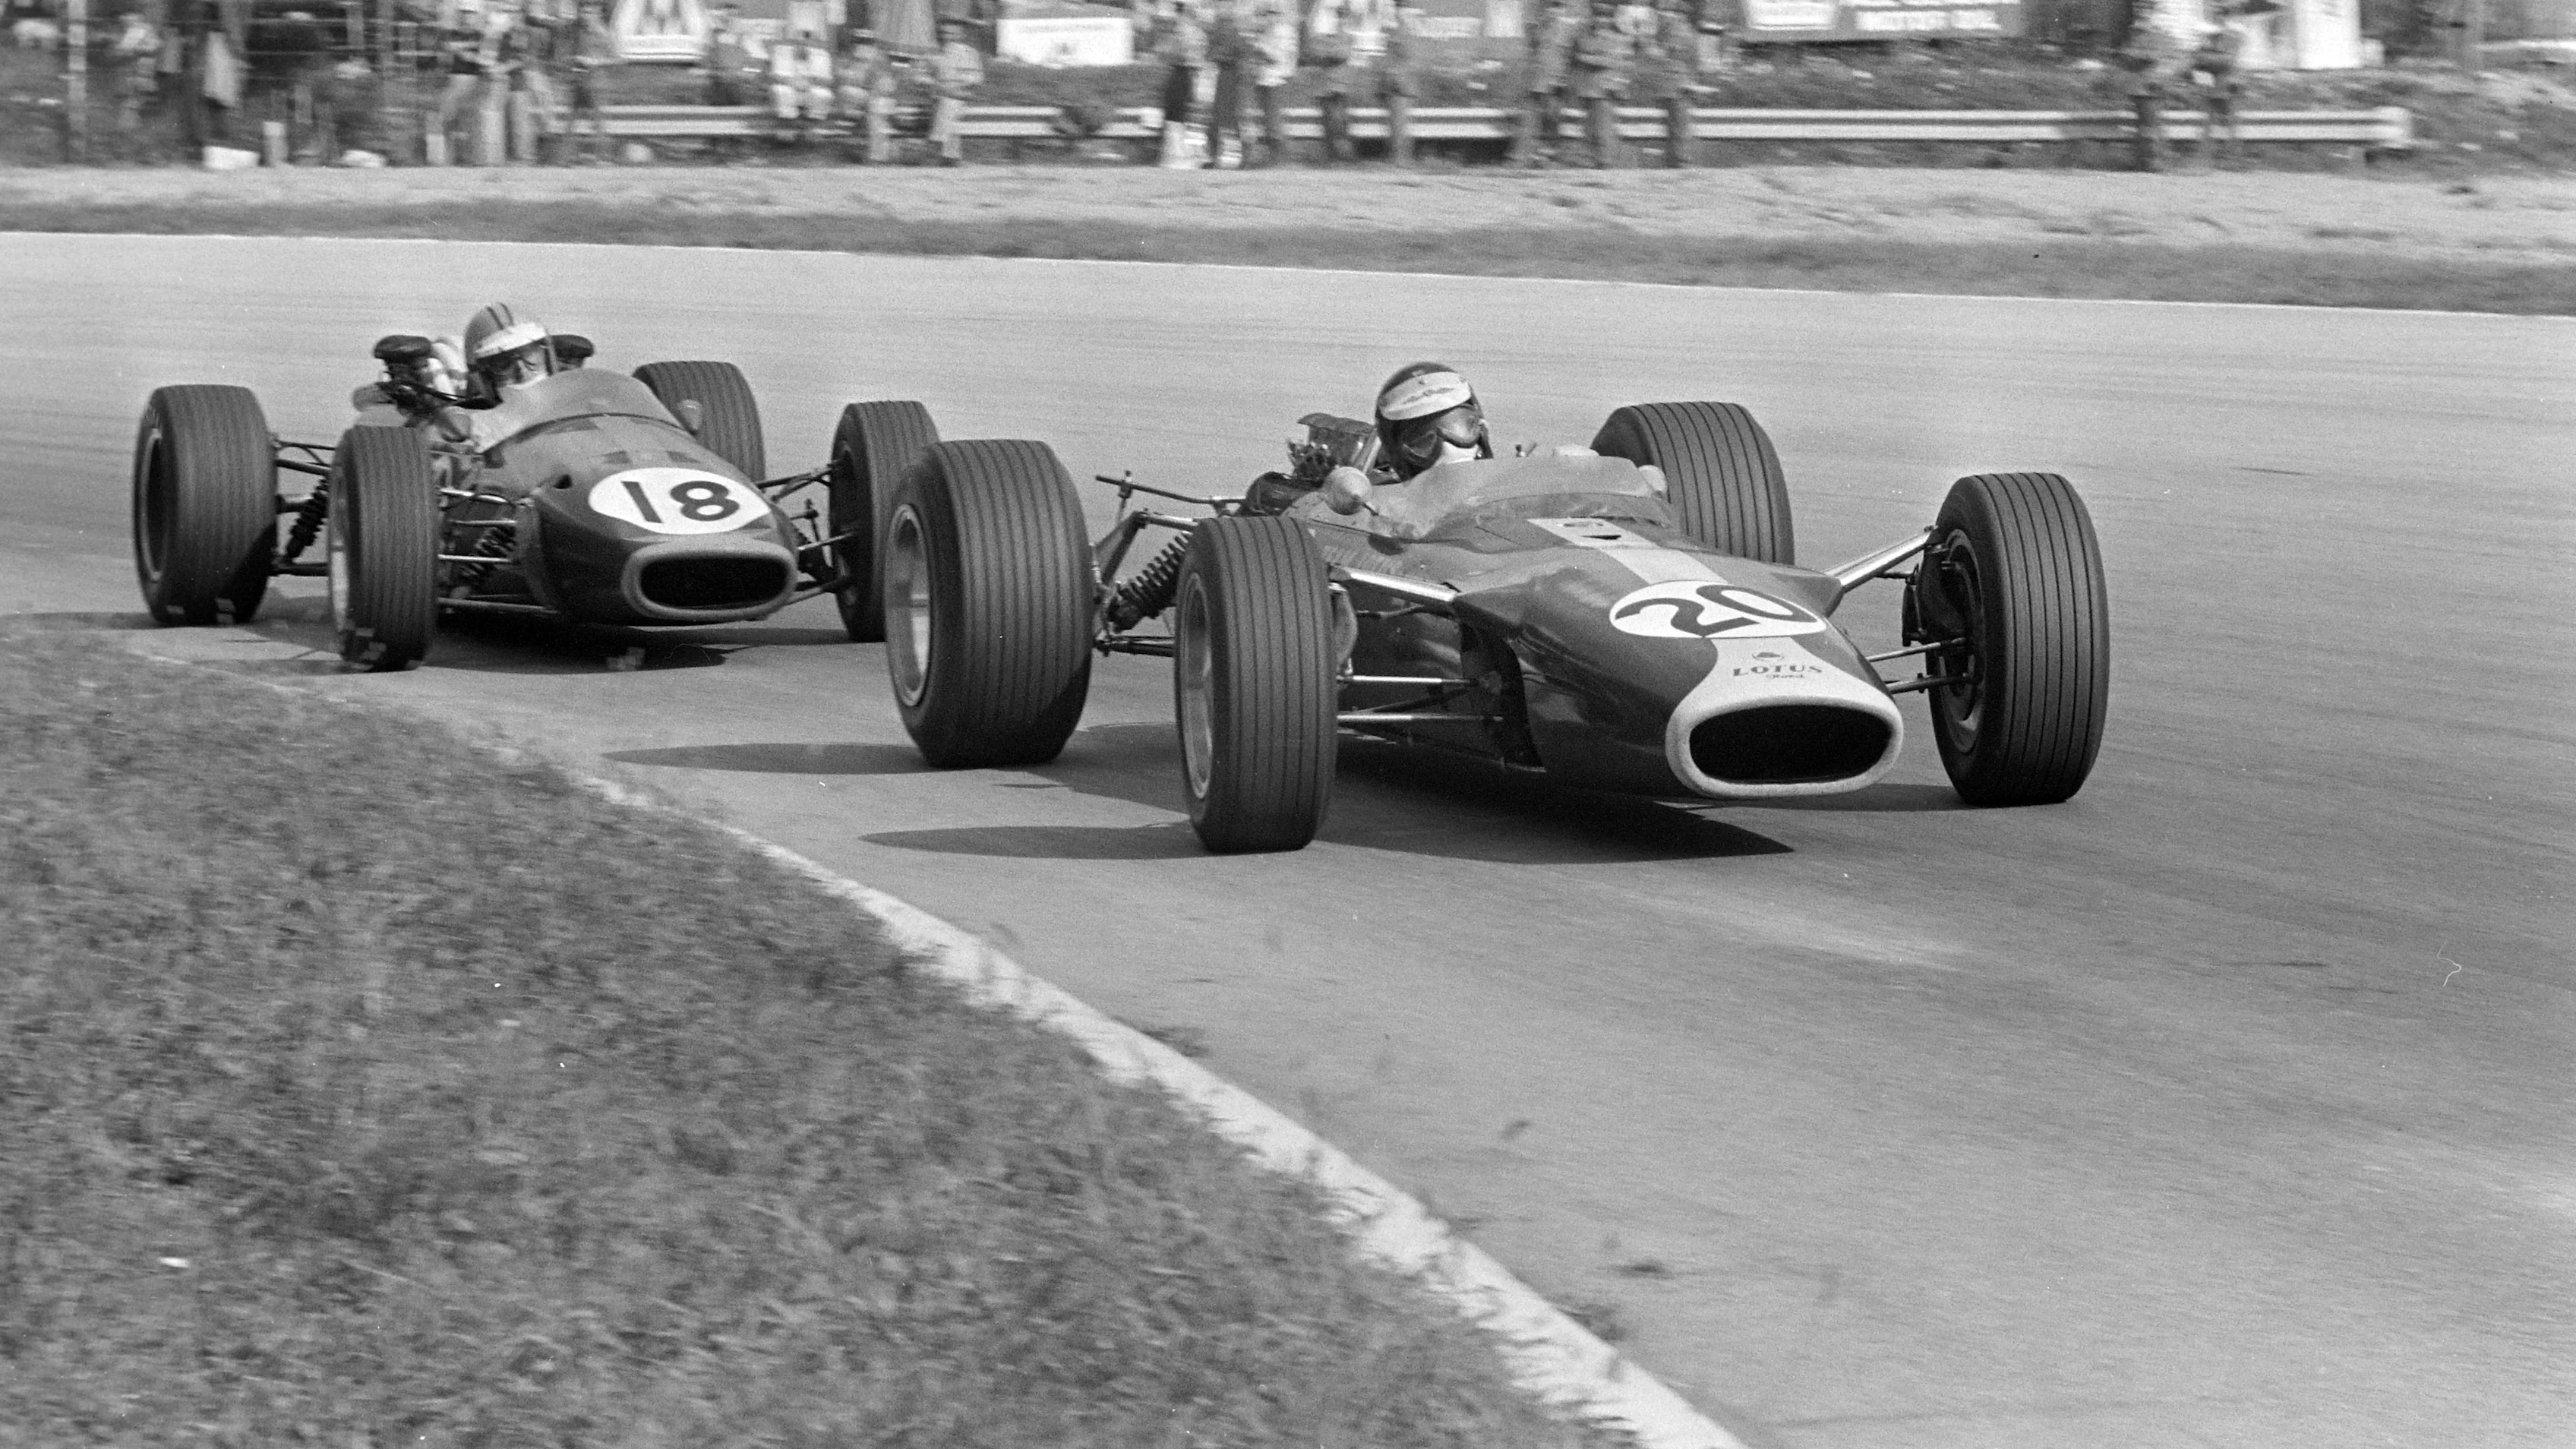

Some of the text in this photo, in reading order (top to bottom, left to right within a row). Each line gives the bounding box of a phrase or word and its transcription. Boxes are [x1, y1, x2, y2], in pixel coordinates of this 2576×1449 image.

[621, 480, 740, 524] 18
[1615, 584, 1818, 638] 20
[1732, 665, 1823, 677] LOTUS
